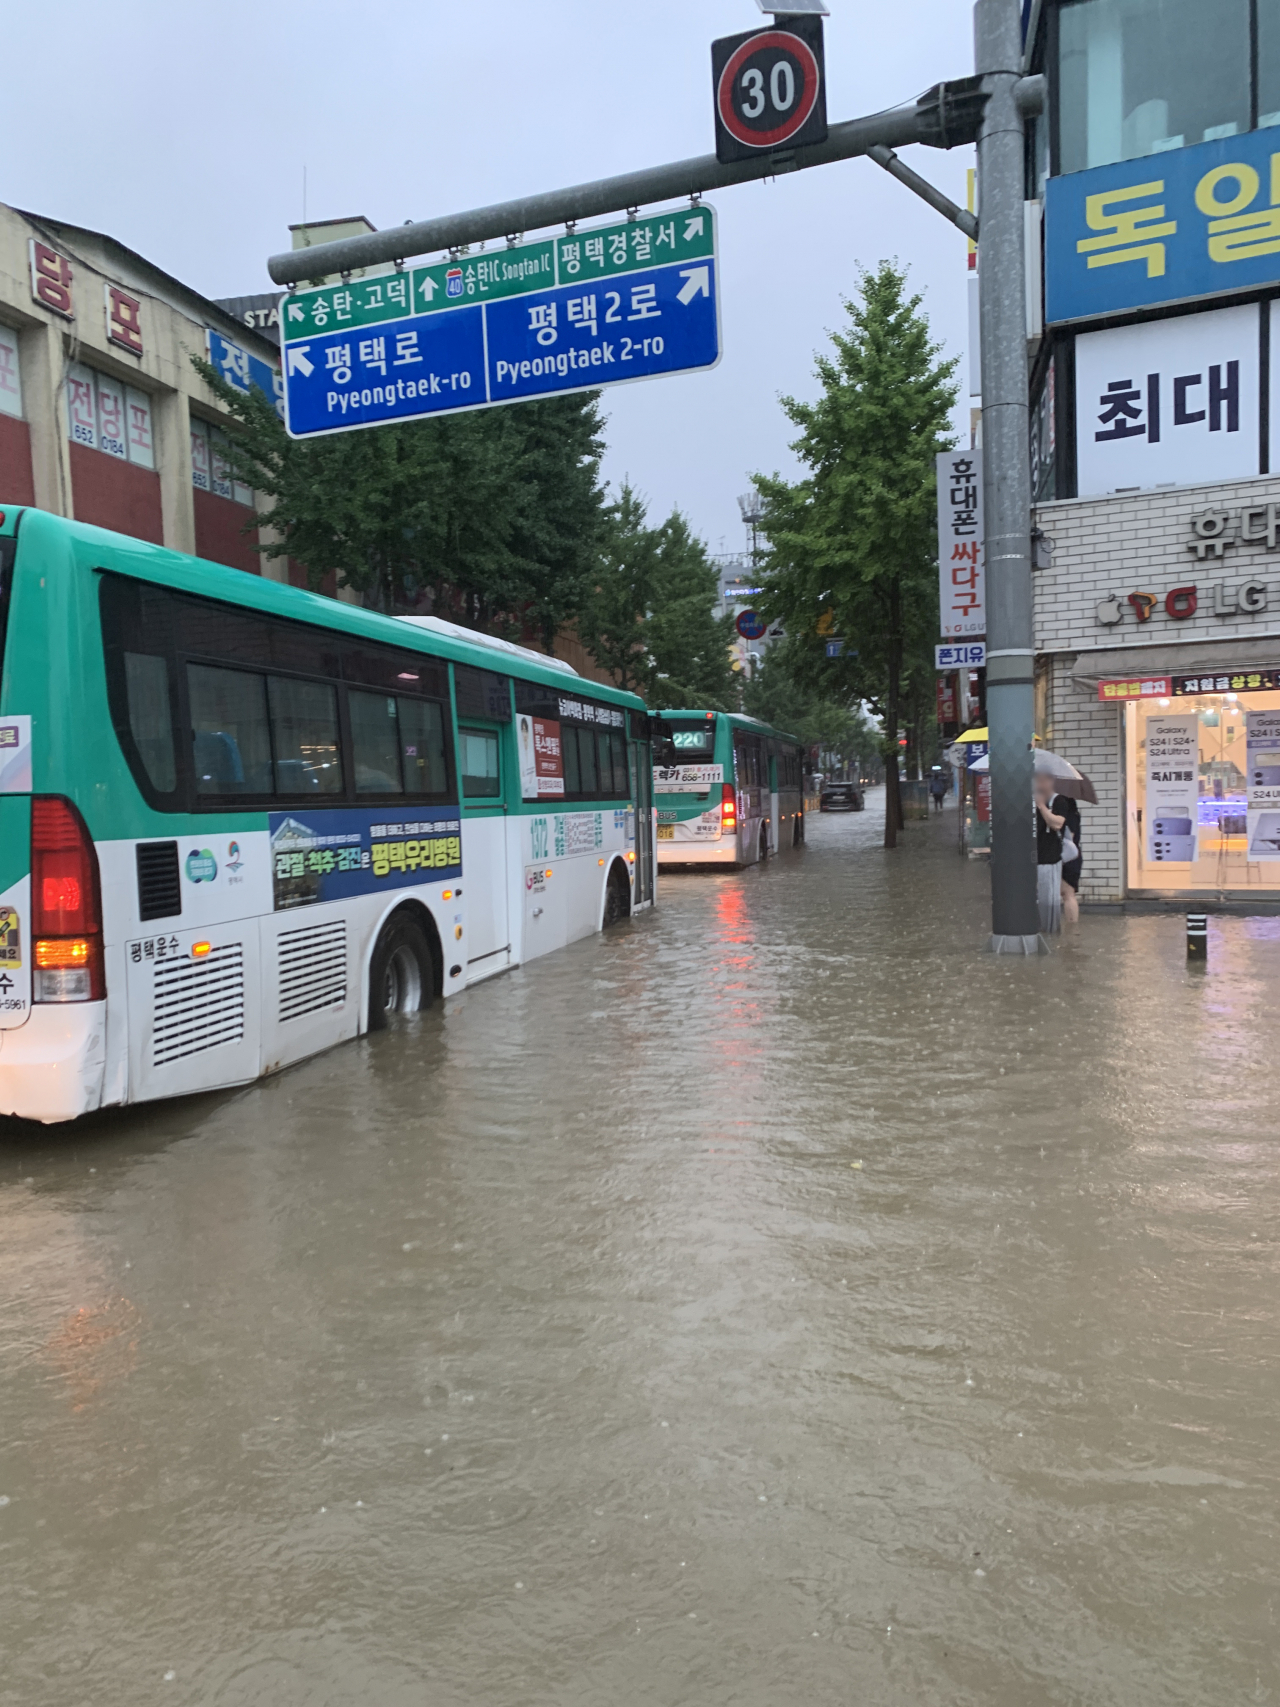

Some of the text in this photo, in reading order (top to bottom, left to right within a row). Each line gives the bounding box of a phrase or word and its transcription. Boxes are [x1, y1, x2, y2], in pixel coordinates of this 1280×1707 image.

[741, 60, 795, 118] 30
[1077, 152, 1280, 279] 독일
[561, 221, 676, 276] 평택경찰서
[502, 253, 551, 281] Songtan IC
[310, 276, 406, 326] 송탄·고덕
[449, 281, 461, 296] 40
[528, 283, 663, 346] 평택2로
[324, 331, 424, 385] 평택로
[496, 336, 665, 384] Pyeongtaek 2-ro
[326, 370, 472, 414] Pyeongtaek-ro
[1095, 360, 1240, 443] 최대
[950, 458, 981, 617] 휴대폰 싸다구
[1213, 580, 1266, 614] LG
[938, 646, 984, 666] 폰지유
[673, 731, 704, 747] 220
[1150, 738, 1167, 746] S24
[1156, 727, 1188, 735] Galaxy
[1250, 729, 1267, 737] S24
[1150, 747, 1190, 756] S24 Ultra
[682, 772, 721, 781] 658-1111
[1253, 790, 1270, 798] S24
[659, 812, 677, 820] BUS
[371, 836, 461, 876] 평택우리병원
[131, 935, 179, 963] 평택운수
[0, 999, 26, 1011] -5961
